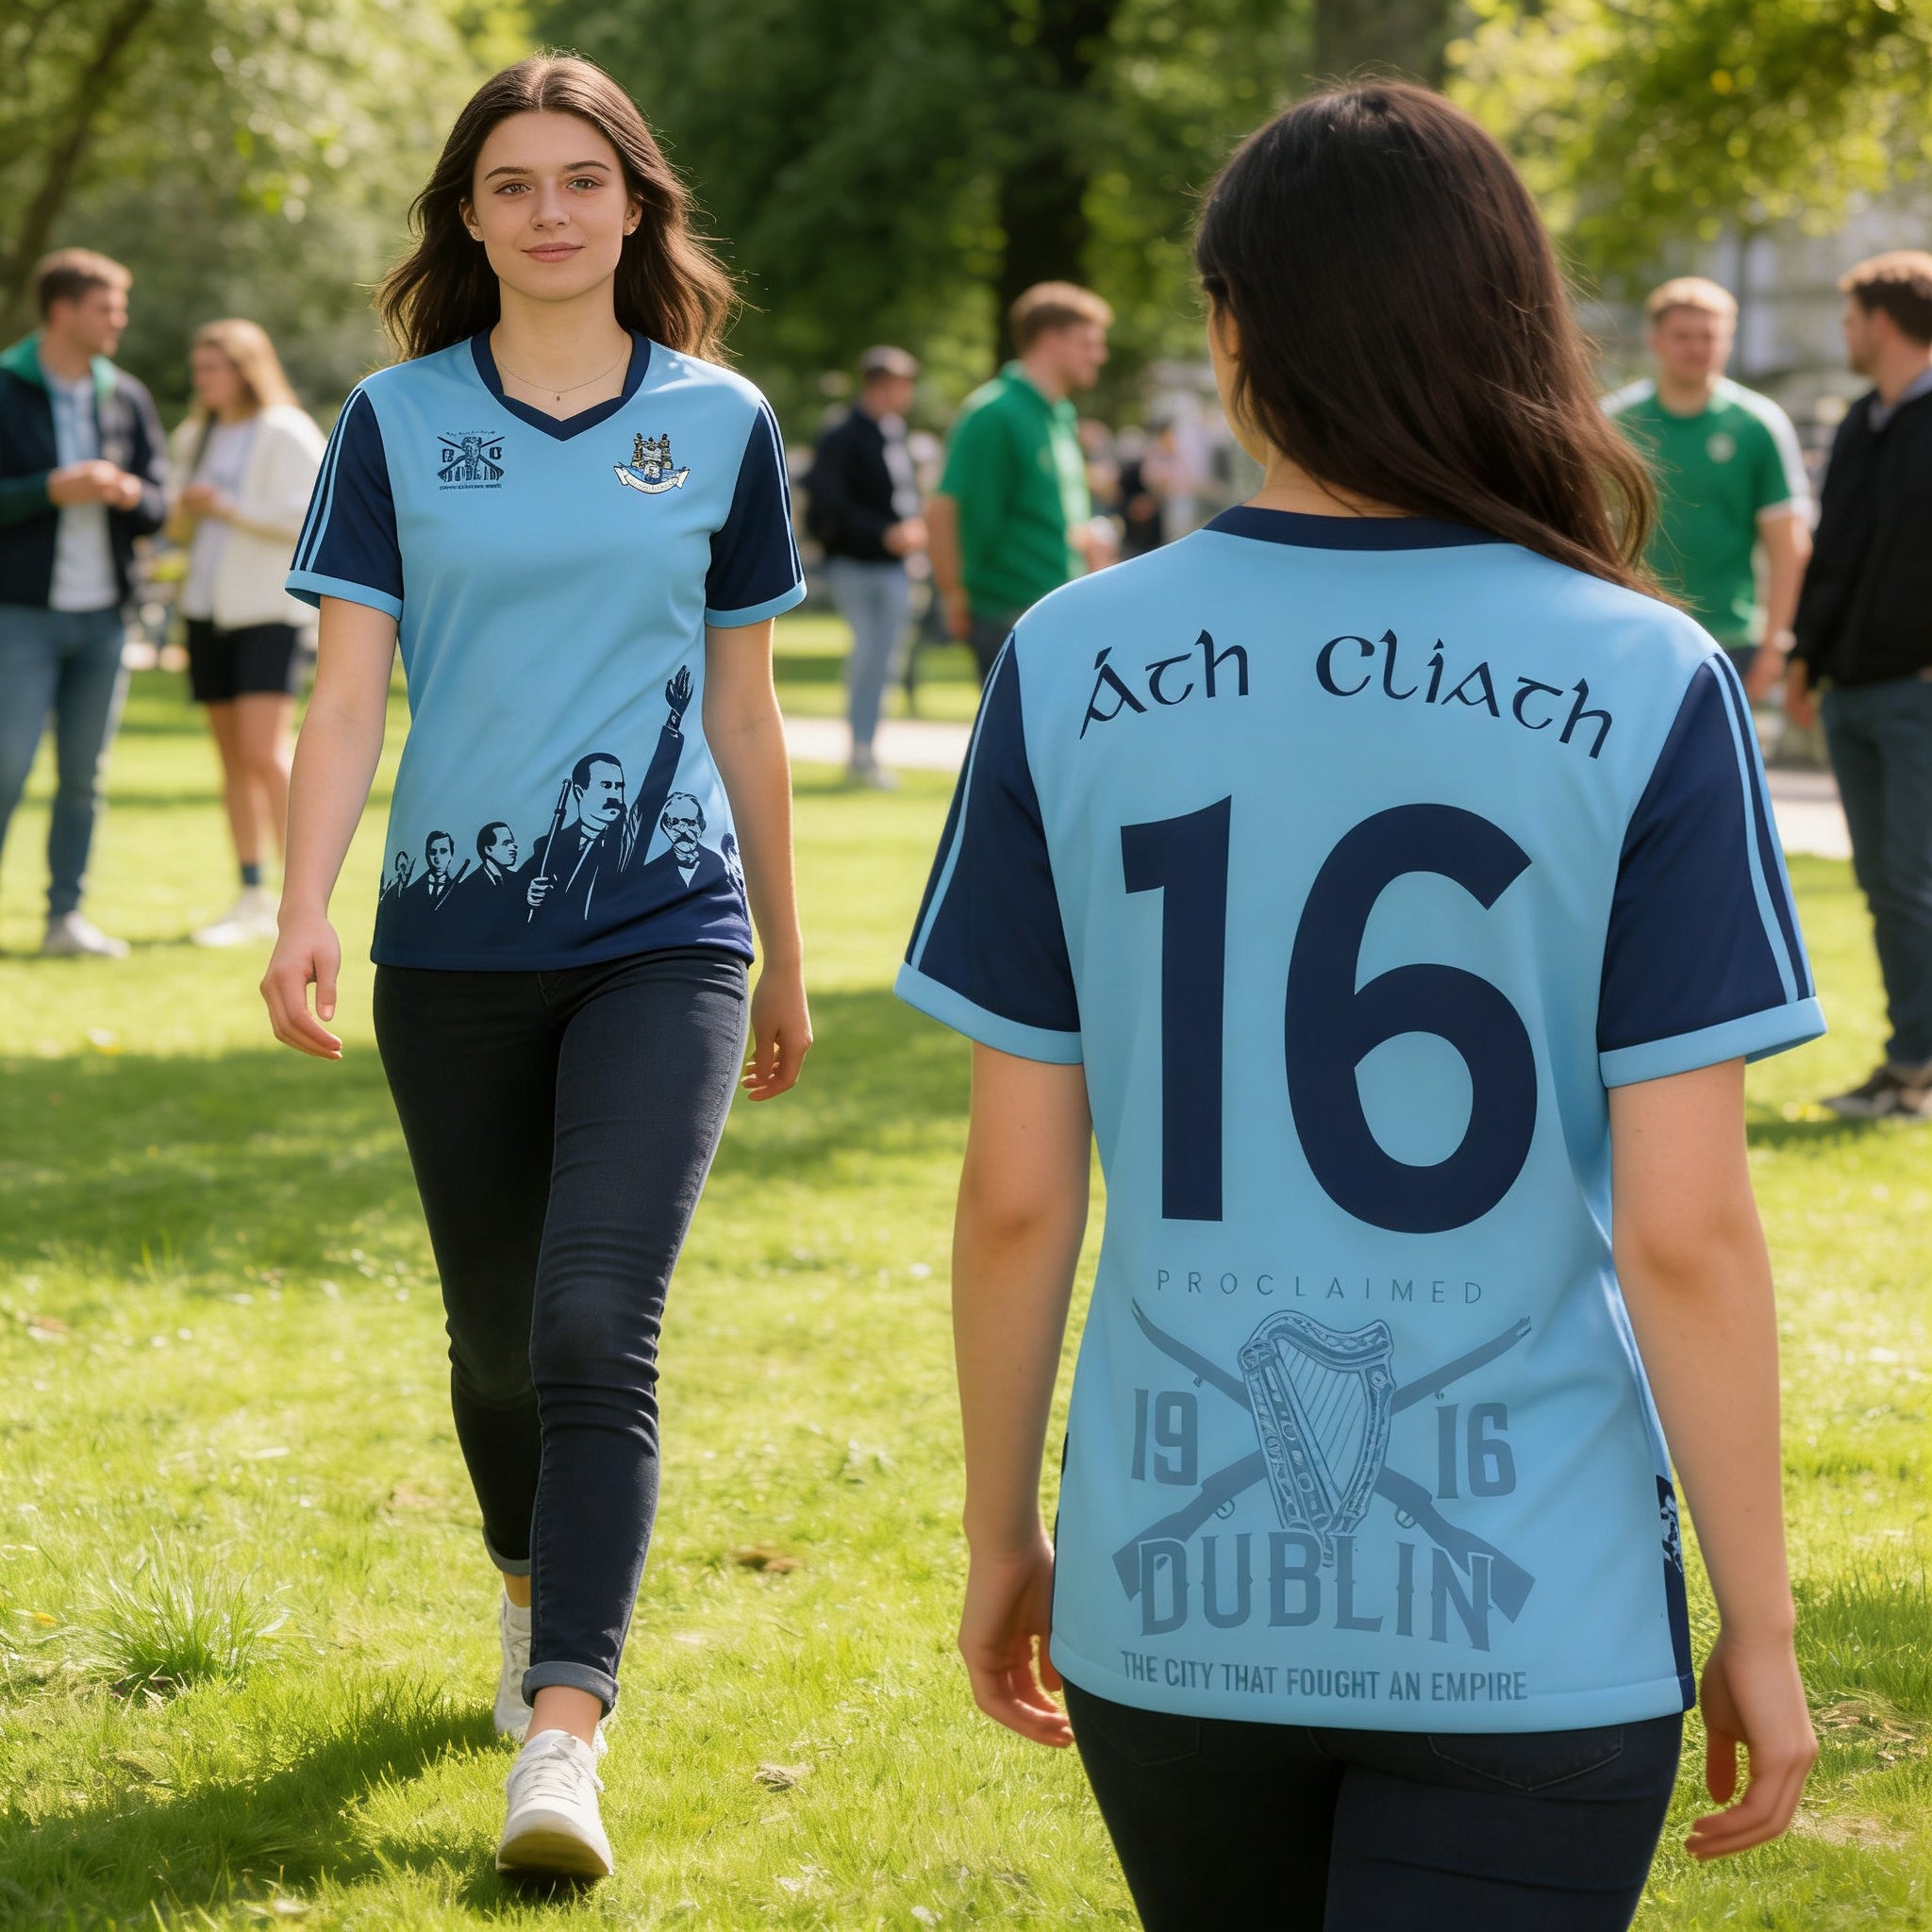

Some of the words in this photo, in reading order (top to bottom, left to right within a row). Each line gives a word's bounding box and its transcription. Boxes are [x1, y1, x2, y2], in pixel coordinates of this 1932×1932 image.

[1120, 794, 1538, 1235] 16
[1157, 1269, 1482, 1305] PROCLAIMED
[1131, 1389, 1198, 1487] 19
[1436, 1402, 1517, 1500] 16
[1139, 1532, 1494, 1653] DUBLIN
[1121, 1650, 1158, 1683] THE
[1165, 1658, 1214, 1690] CITY
[1221, 1663, 1278, 1695] THAT
[1287, 1668, 1380, 1699] FOUGHT
[1389, 1671, 1421, 1702] AN
[1431, 1671, 1528, 1702] EMPIRE
